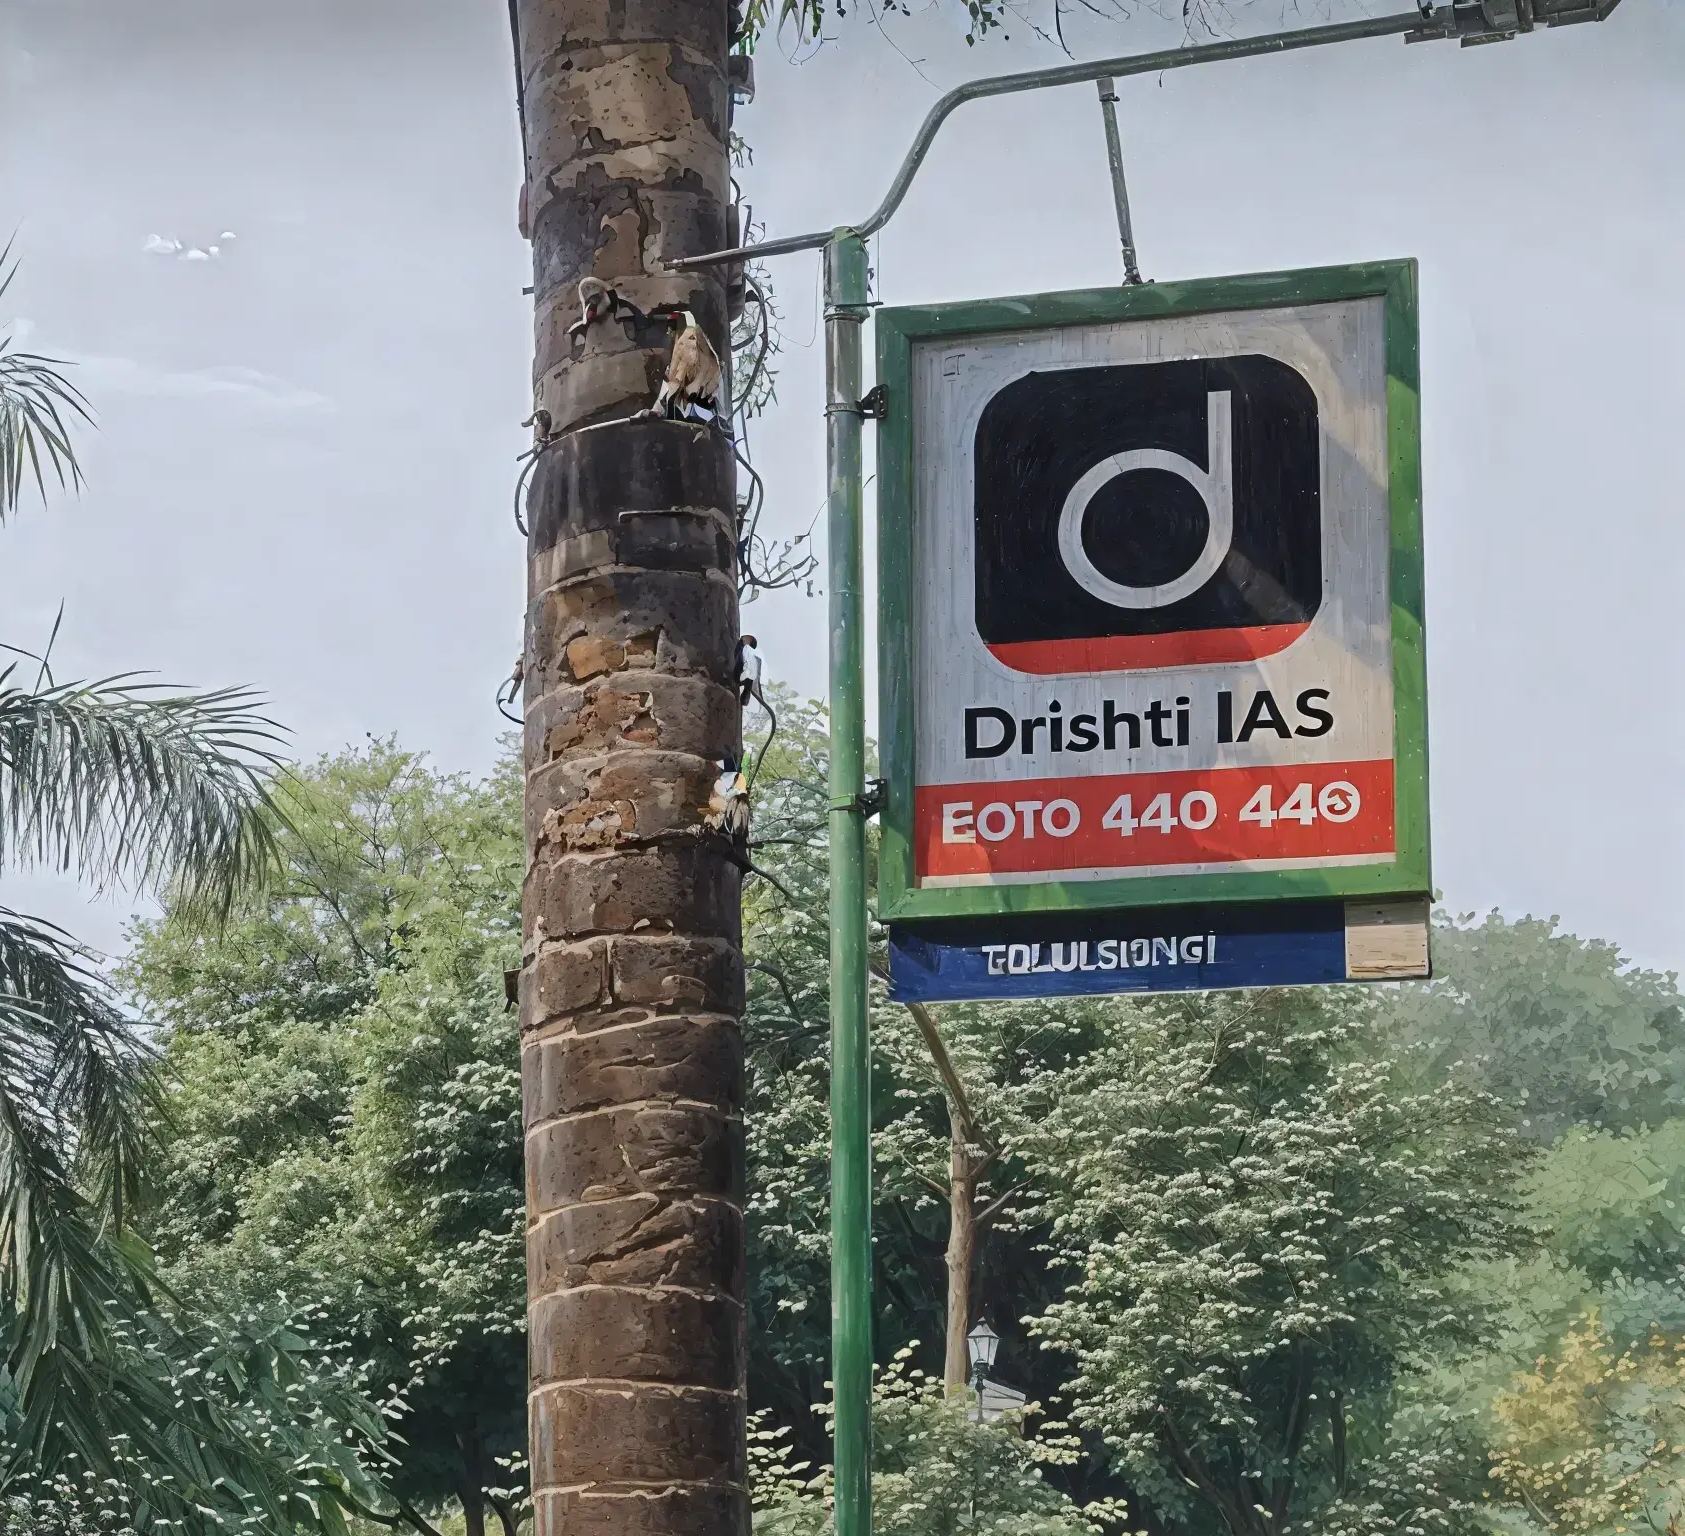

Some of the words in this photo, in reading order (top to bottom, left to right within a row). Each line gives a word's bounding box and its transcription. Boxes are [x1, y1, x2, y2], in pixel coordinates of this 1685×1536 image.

[964, 698, 1191, 759] Drishti
[1217, 689, 1335, 744] IAS
[1102, 790, 1218, 836] 440
